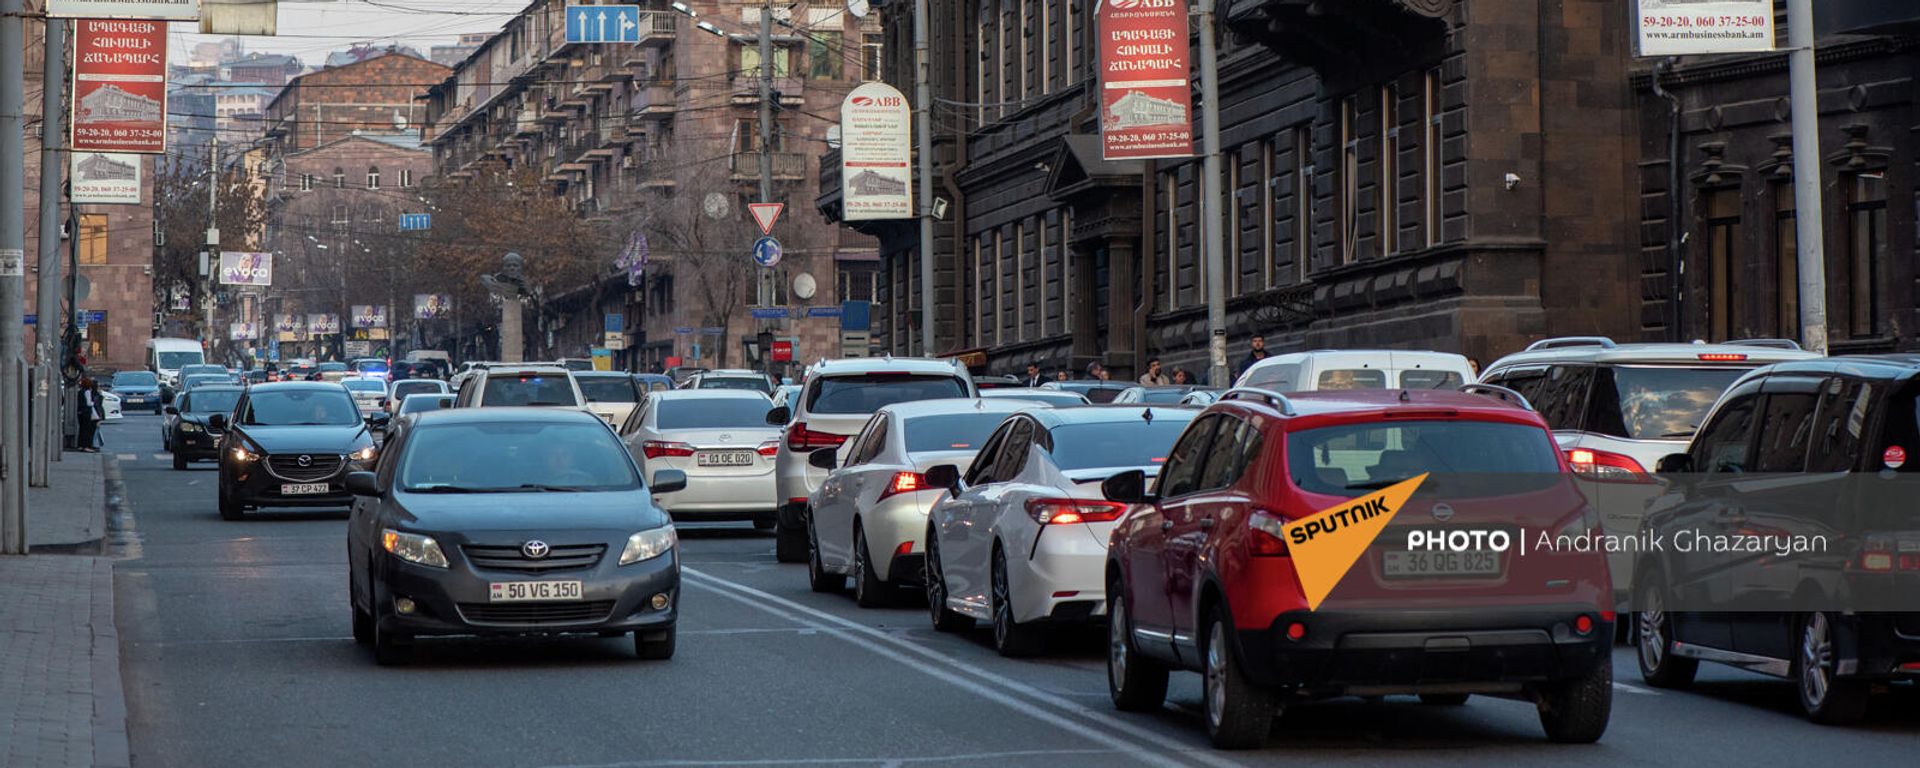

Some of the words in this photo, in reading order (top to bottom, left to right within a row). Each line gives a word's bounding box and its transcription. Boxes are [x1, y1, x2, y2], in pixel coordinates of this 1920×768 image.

[1140, 0, 1175, 8] ABB
[1643, 16, 1693, 27] 59-20-20,
[1696, 16, 1715, 27] 060
[1718, 15, 1765, 27] 37-25-00
[1646, 30, 1764, 40] www.armbusinessbank.am
[873, 96, 901, 107] ABB
[114, 128, 128, 137] 060
[130, 129, 162, 138] 37-25-00
[1142, 133, 1156, 141] 060
[1158, 131, 1189, 141] 37-25-00
[223, 267, 268, 278] evoca
[1408, 553, 1428, 572] 36
[1433, 553, 1458, 572] QG
[1463, 552, 1494, 571] 825
[508, 583, 526, 598] 50
[529, 583, 549, 598] VG
[553, 582, 578, 597] 150
